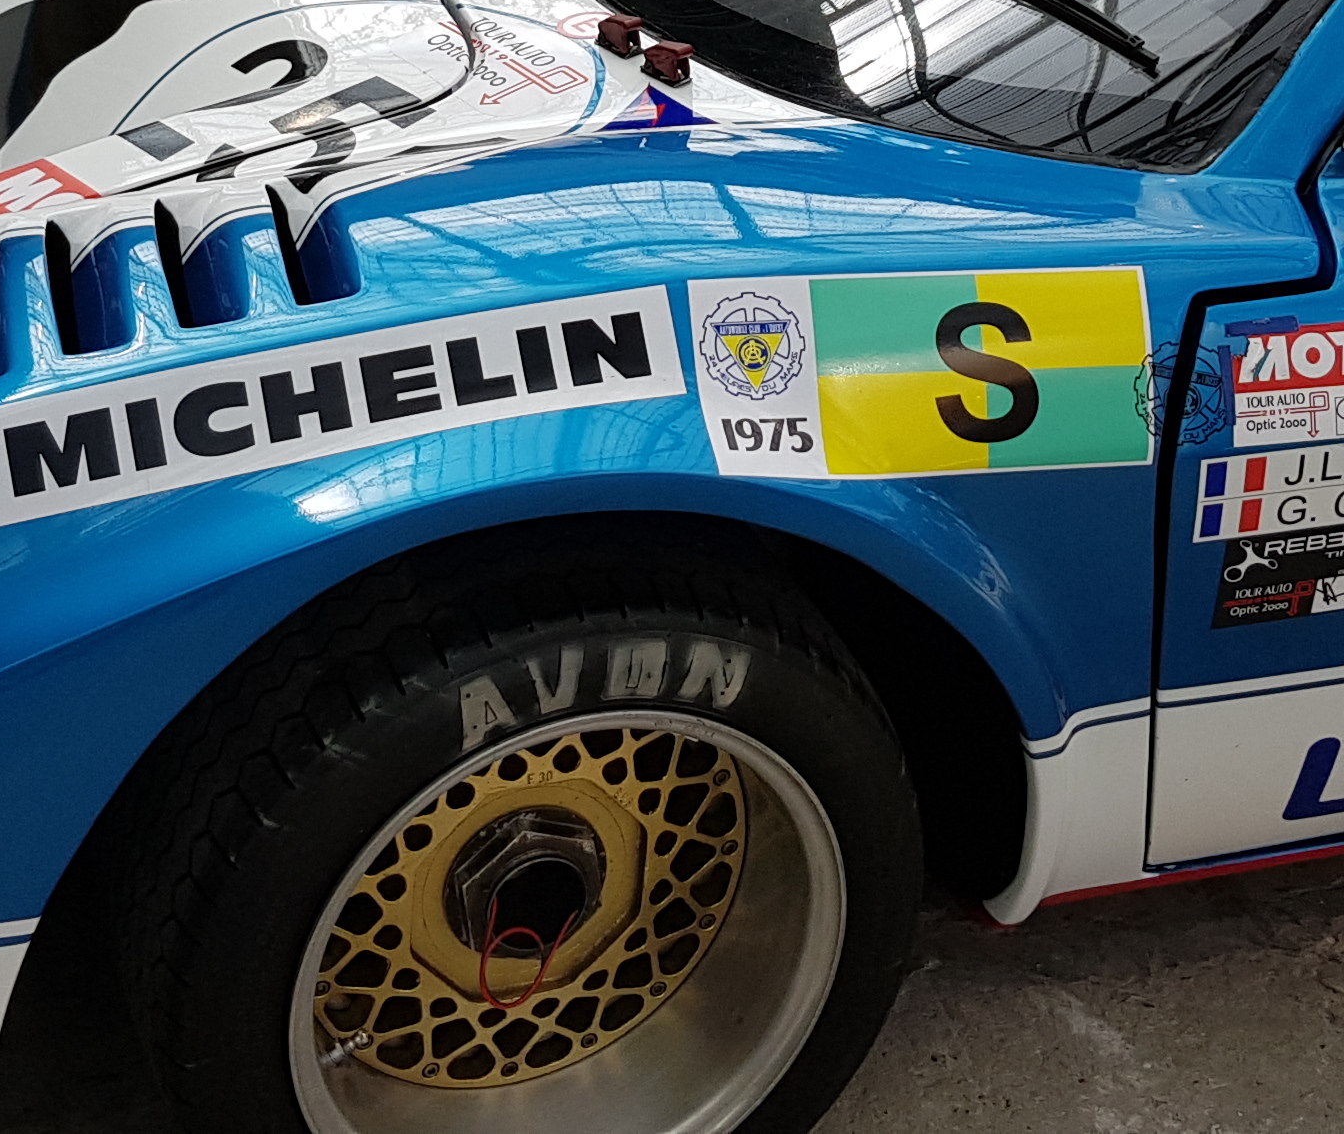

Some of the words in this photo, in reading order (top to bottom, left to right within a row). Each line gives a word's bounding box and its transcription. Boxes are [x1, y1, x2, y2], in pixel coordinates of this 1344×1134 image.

[427, 33, 470, 62] Optic
[508, 36, 556, 67] AUTO
[934, 301, 1040, 444] S
[2, 310, 653, 497] MICHELIN
[1246, 394, 1275, 409] TOUR
[1276, 392, 1306, 406] AUTO
[1262, 408, 1290, 416] 2017
[719, 416, 814, 453] 1975
[1246, 418, 1277, 434] Optic
[1279, 417, 1307, 429] 2000
[1276, 494, 1318, 526] G.
[1235, 585, 1263, 600] TOUR
[1264, 582, 1293, 596] AUTO
[1229, 603, 1261, 618] Optic
[1261, 601, 1289, 613] 2000
